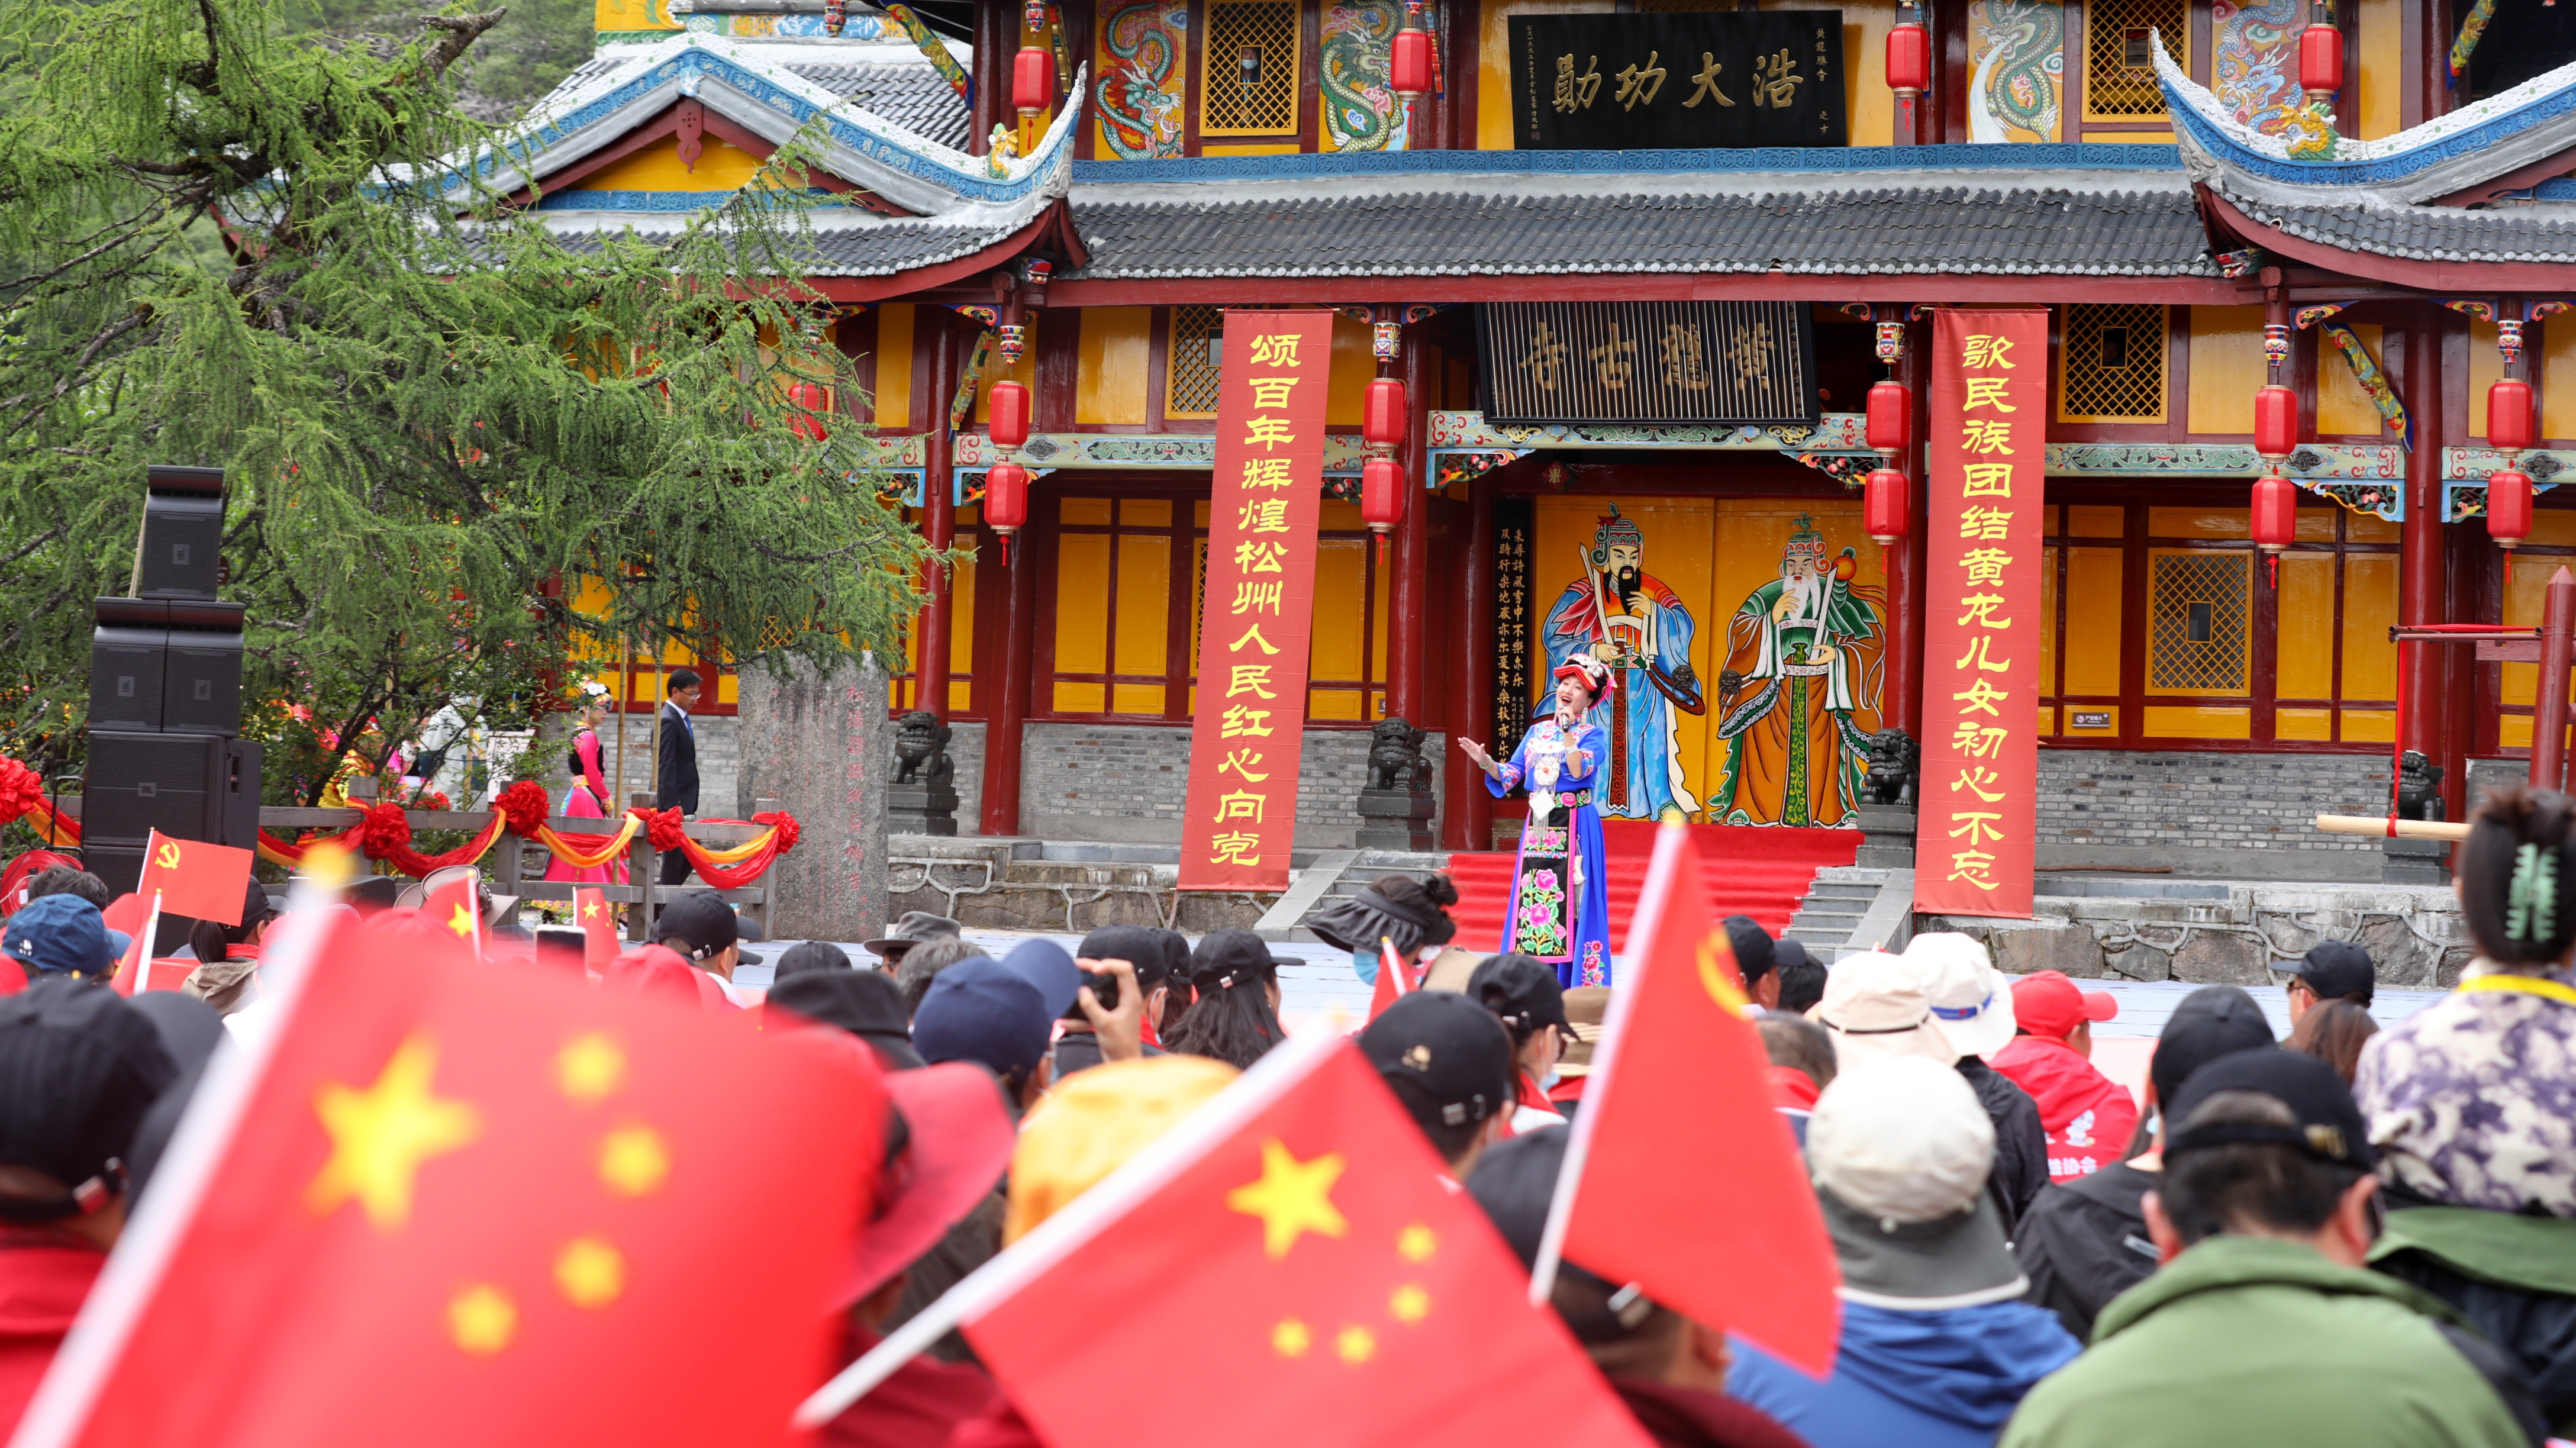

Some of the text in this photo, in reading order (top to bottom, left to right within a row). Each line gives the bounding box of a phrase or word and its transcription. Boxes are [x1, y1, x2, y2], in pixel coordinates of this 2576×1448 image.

[1210, 334, 1302, 866] 颂百年辉煌松州人民红心向党
[1947, 334, 2017, 890] 歌民族团结黄龙儿女初心不忘
